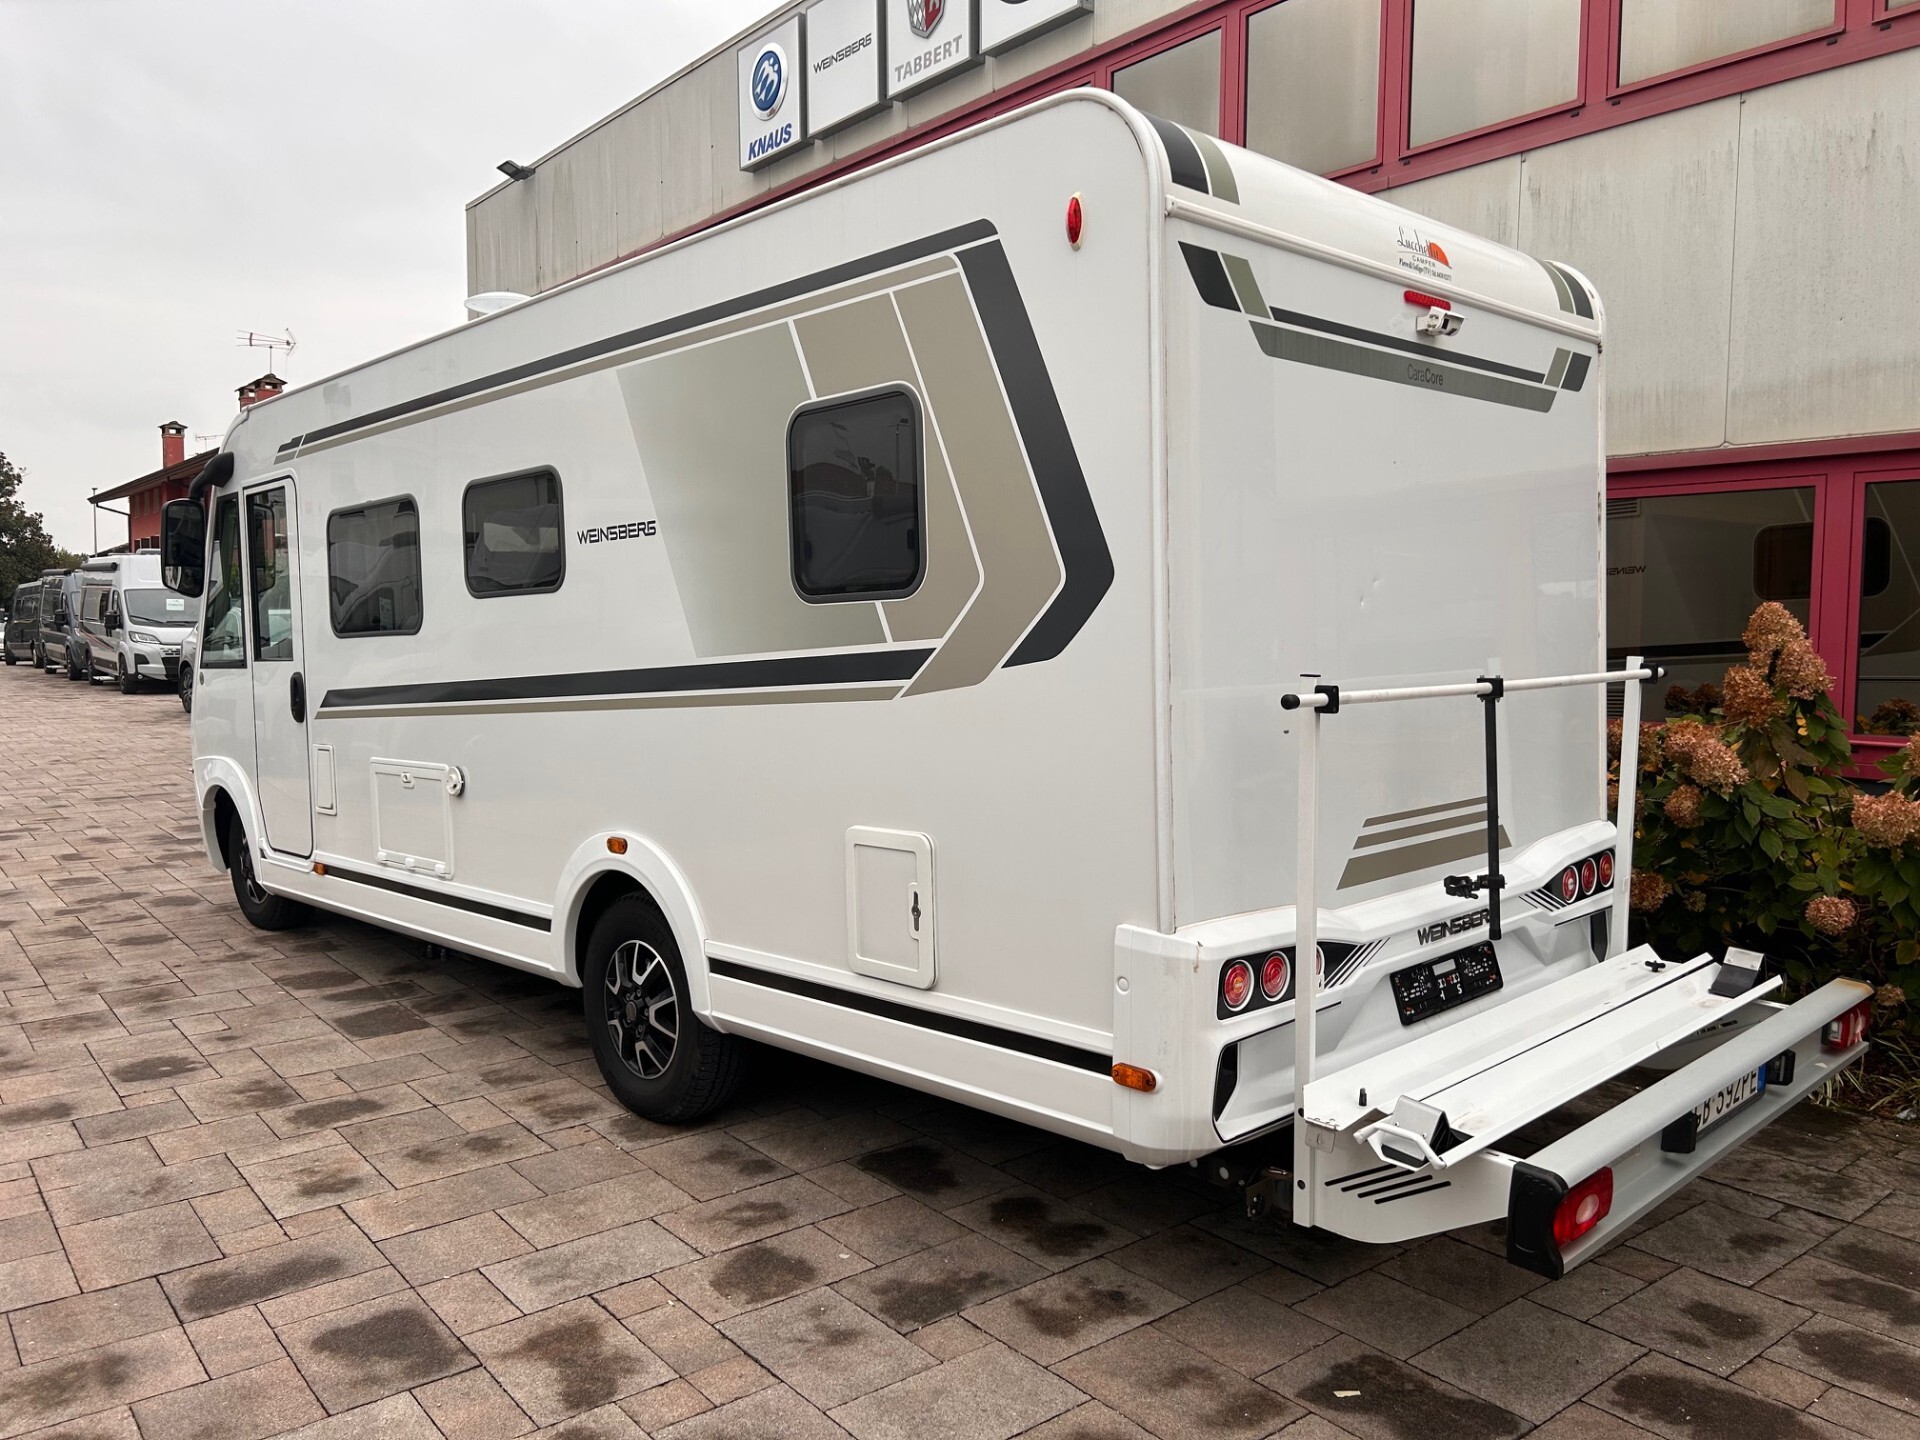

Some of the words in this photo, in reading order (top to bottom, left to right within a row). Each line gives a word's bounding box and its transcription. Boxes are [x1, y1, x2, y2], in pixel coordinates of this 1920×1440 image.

[813, 33, 872, 74] WEINSBERG
[894, 34, 963, 82] TABBERT
[748, 123, 792, 161] KNAUS
[1411, 254, 1436, 268] CAMPER
[1407, 363, 1444, 386] CaraCore
[577, 520, 656, 545] WEINSBERG
[1417, 908, 1490, 946] WEINSBER
